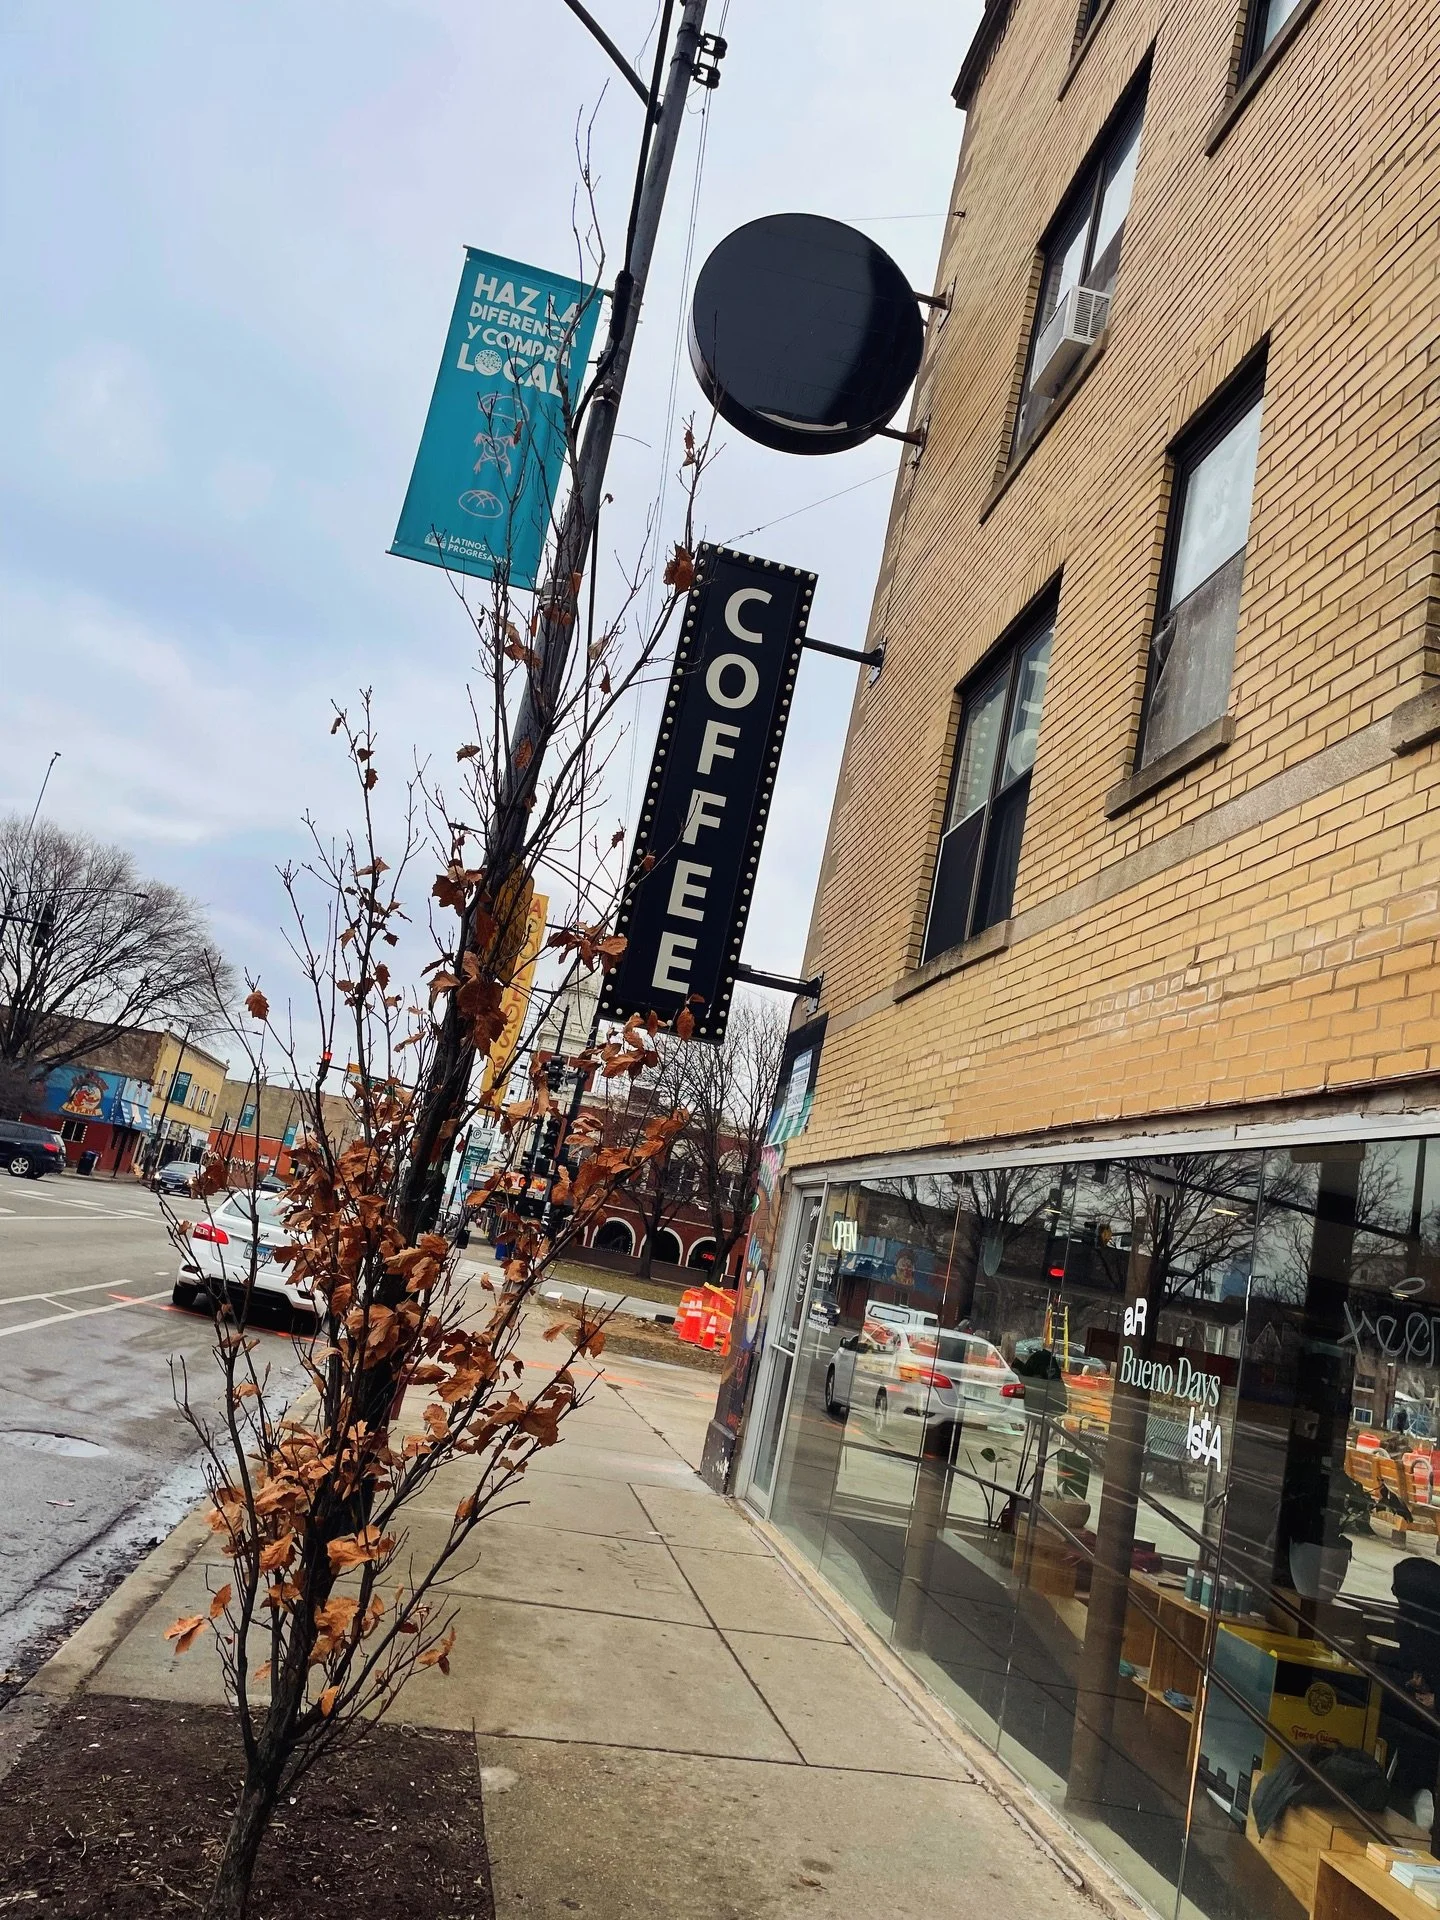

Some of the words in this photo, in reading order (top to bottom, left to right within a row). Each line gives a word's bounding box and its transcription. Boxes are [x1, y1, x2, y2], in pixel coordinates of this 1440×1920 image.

[474, 273, 541, 315] HAZ
[545, 294, 581, 329] LA
[467, 322, 482, 340] Y
[449, 535, 487, 552] LATINOS
[651, 587, 773, 995] COFFEE
[832, 1220, 858, 1252] OPEN
[1119, 1345, 1174, 1395] Bueno
[1174, 1356, 1221, 1411] Days
